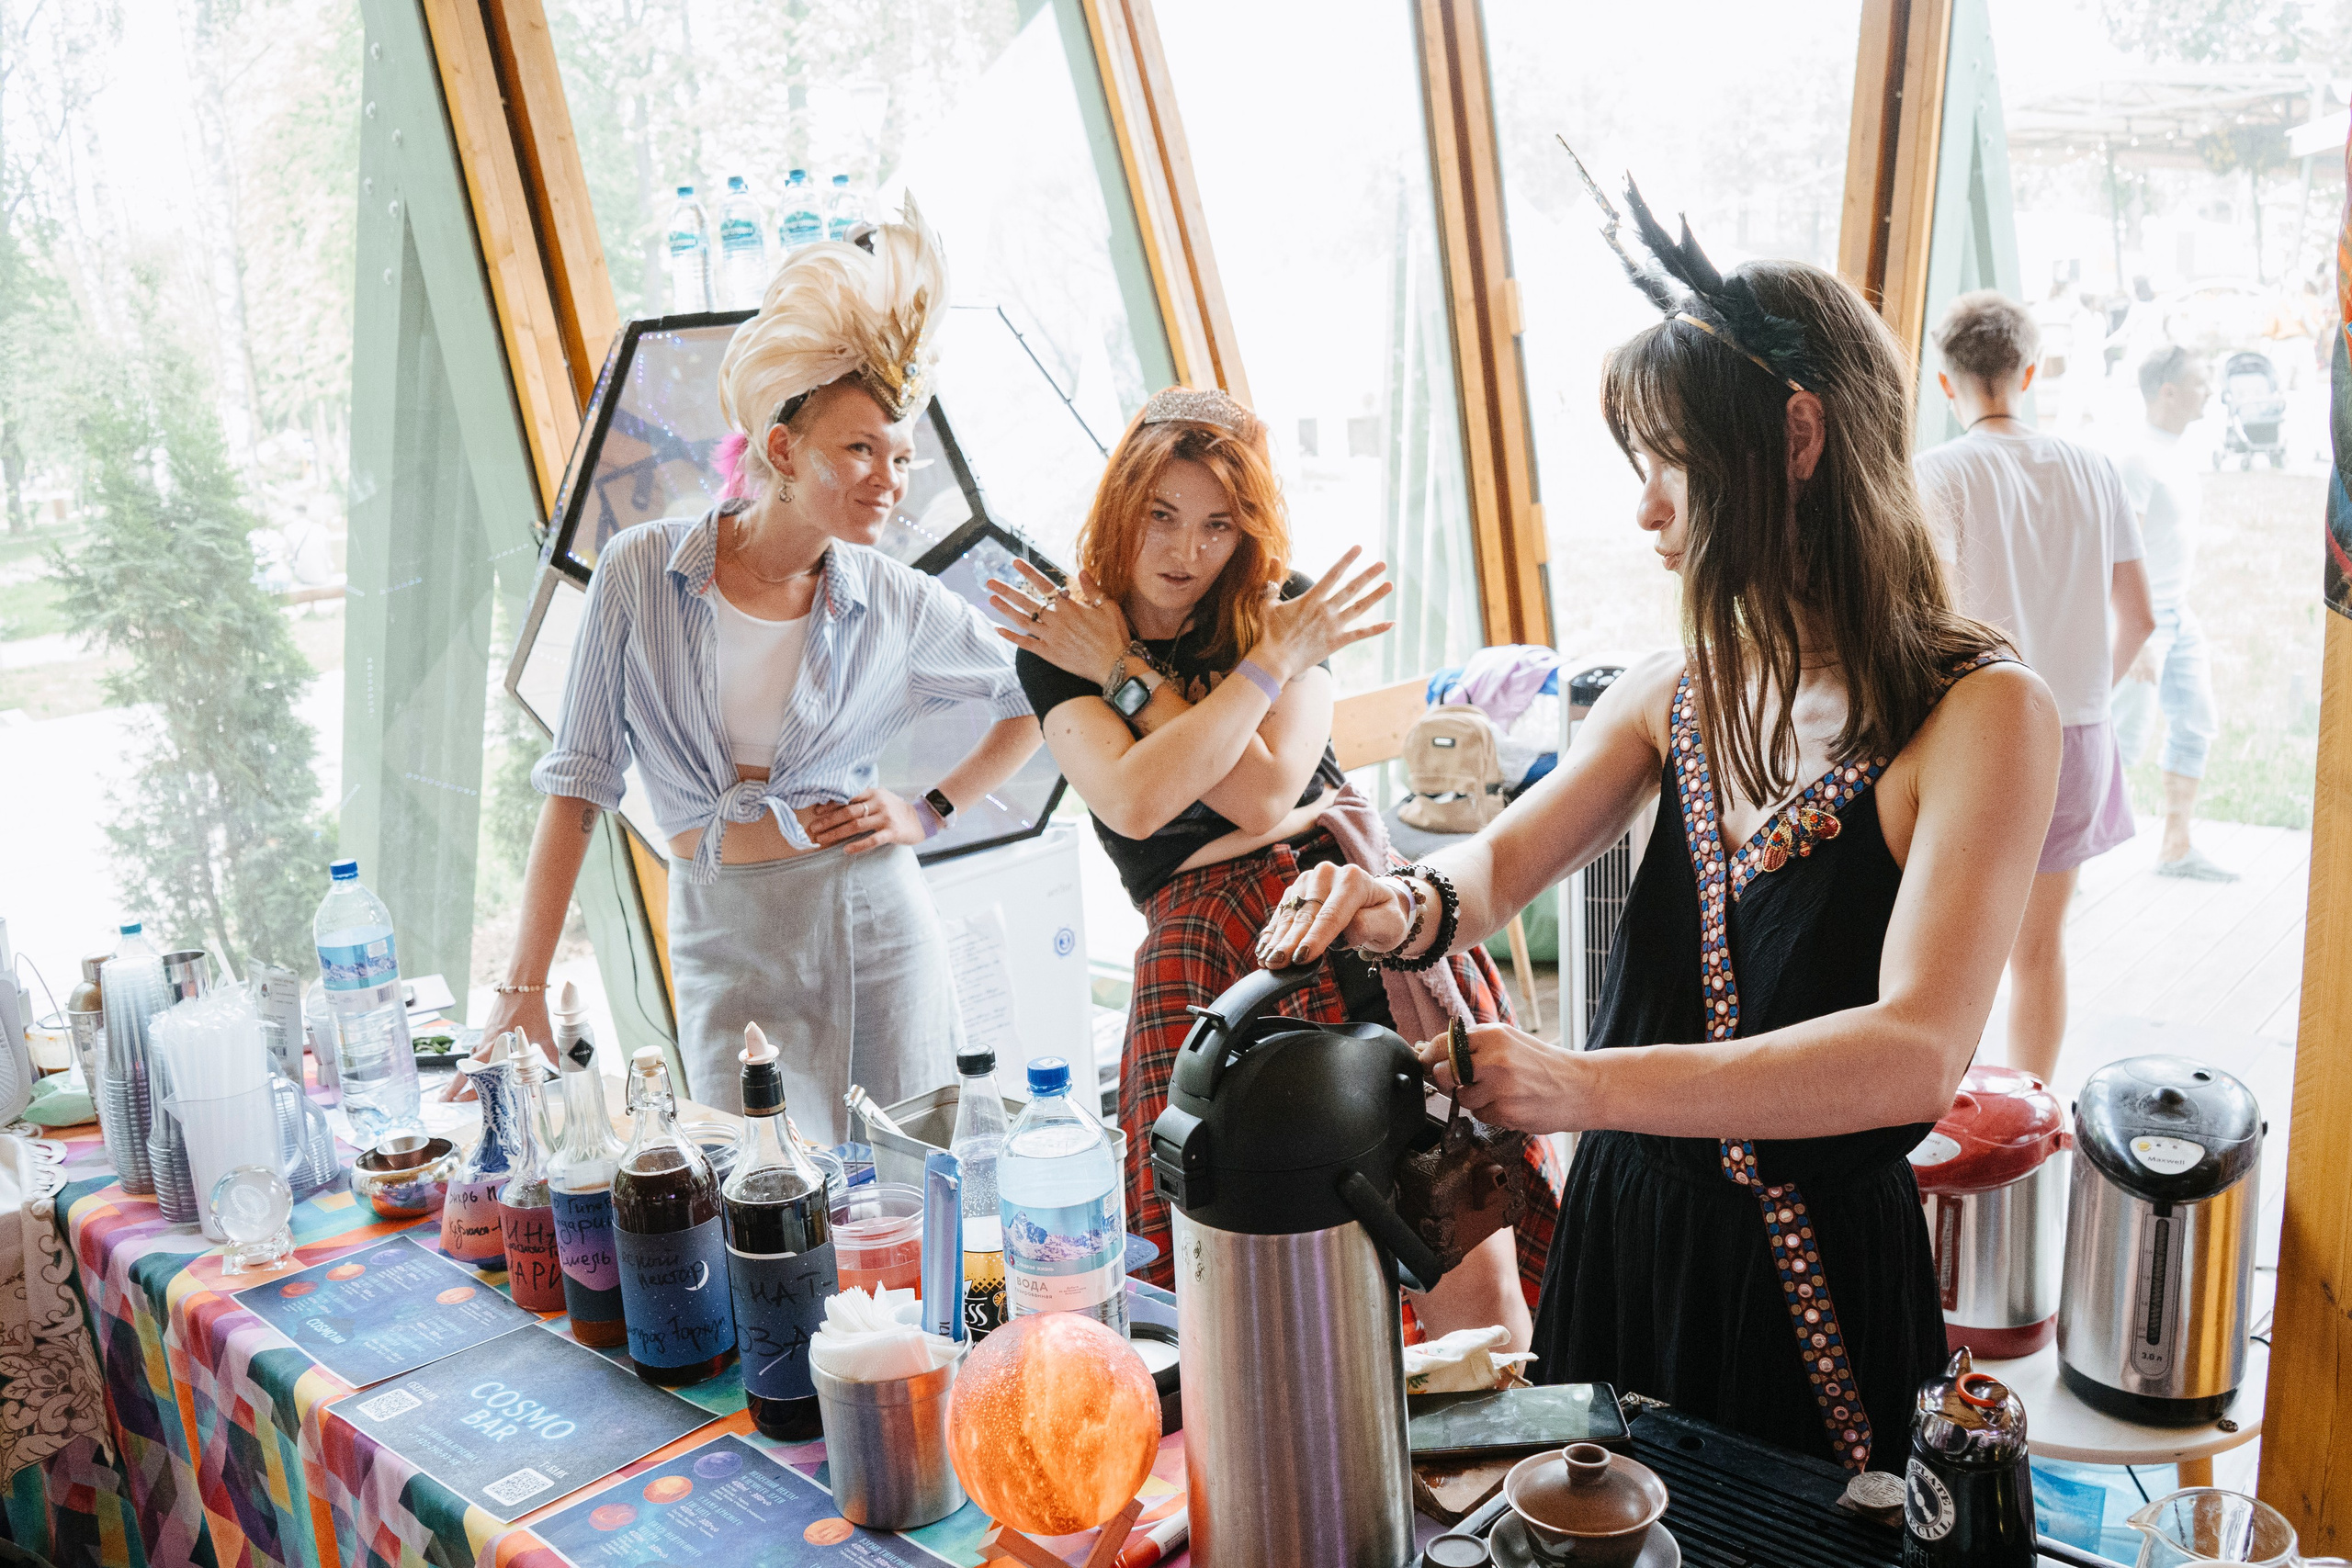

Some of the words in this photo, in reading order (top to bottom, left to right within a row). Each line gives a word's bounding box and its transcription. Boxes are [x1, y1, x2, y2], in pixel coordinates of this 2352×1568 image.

[2147, 1156, 2185, 1165] Maxwell
[1016, 1277, 1048, 1292] ВОДА
[306, 1318, 337, 1339] COSMO
[2141, 1351, 2155, 1361] 3.0
[470, 1382, 576, 1439] COSMO
[459, 1409, 518, 1443] BAR
